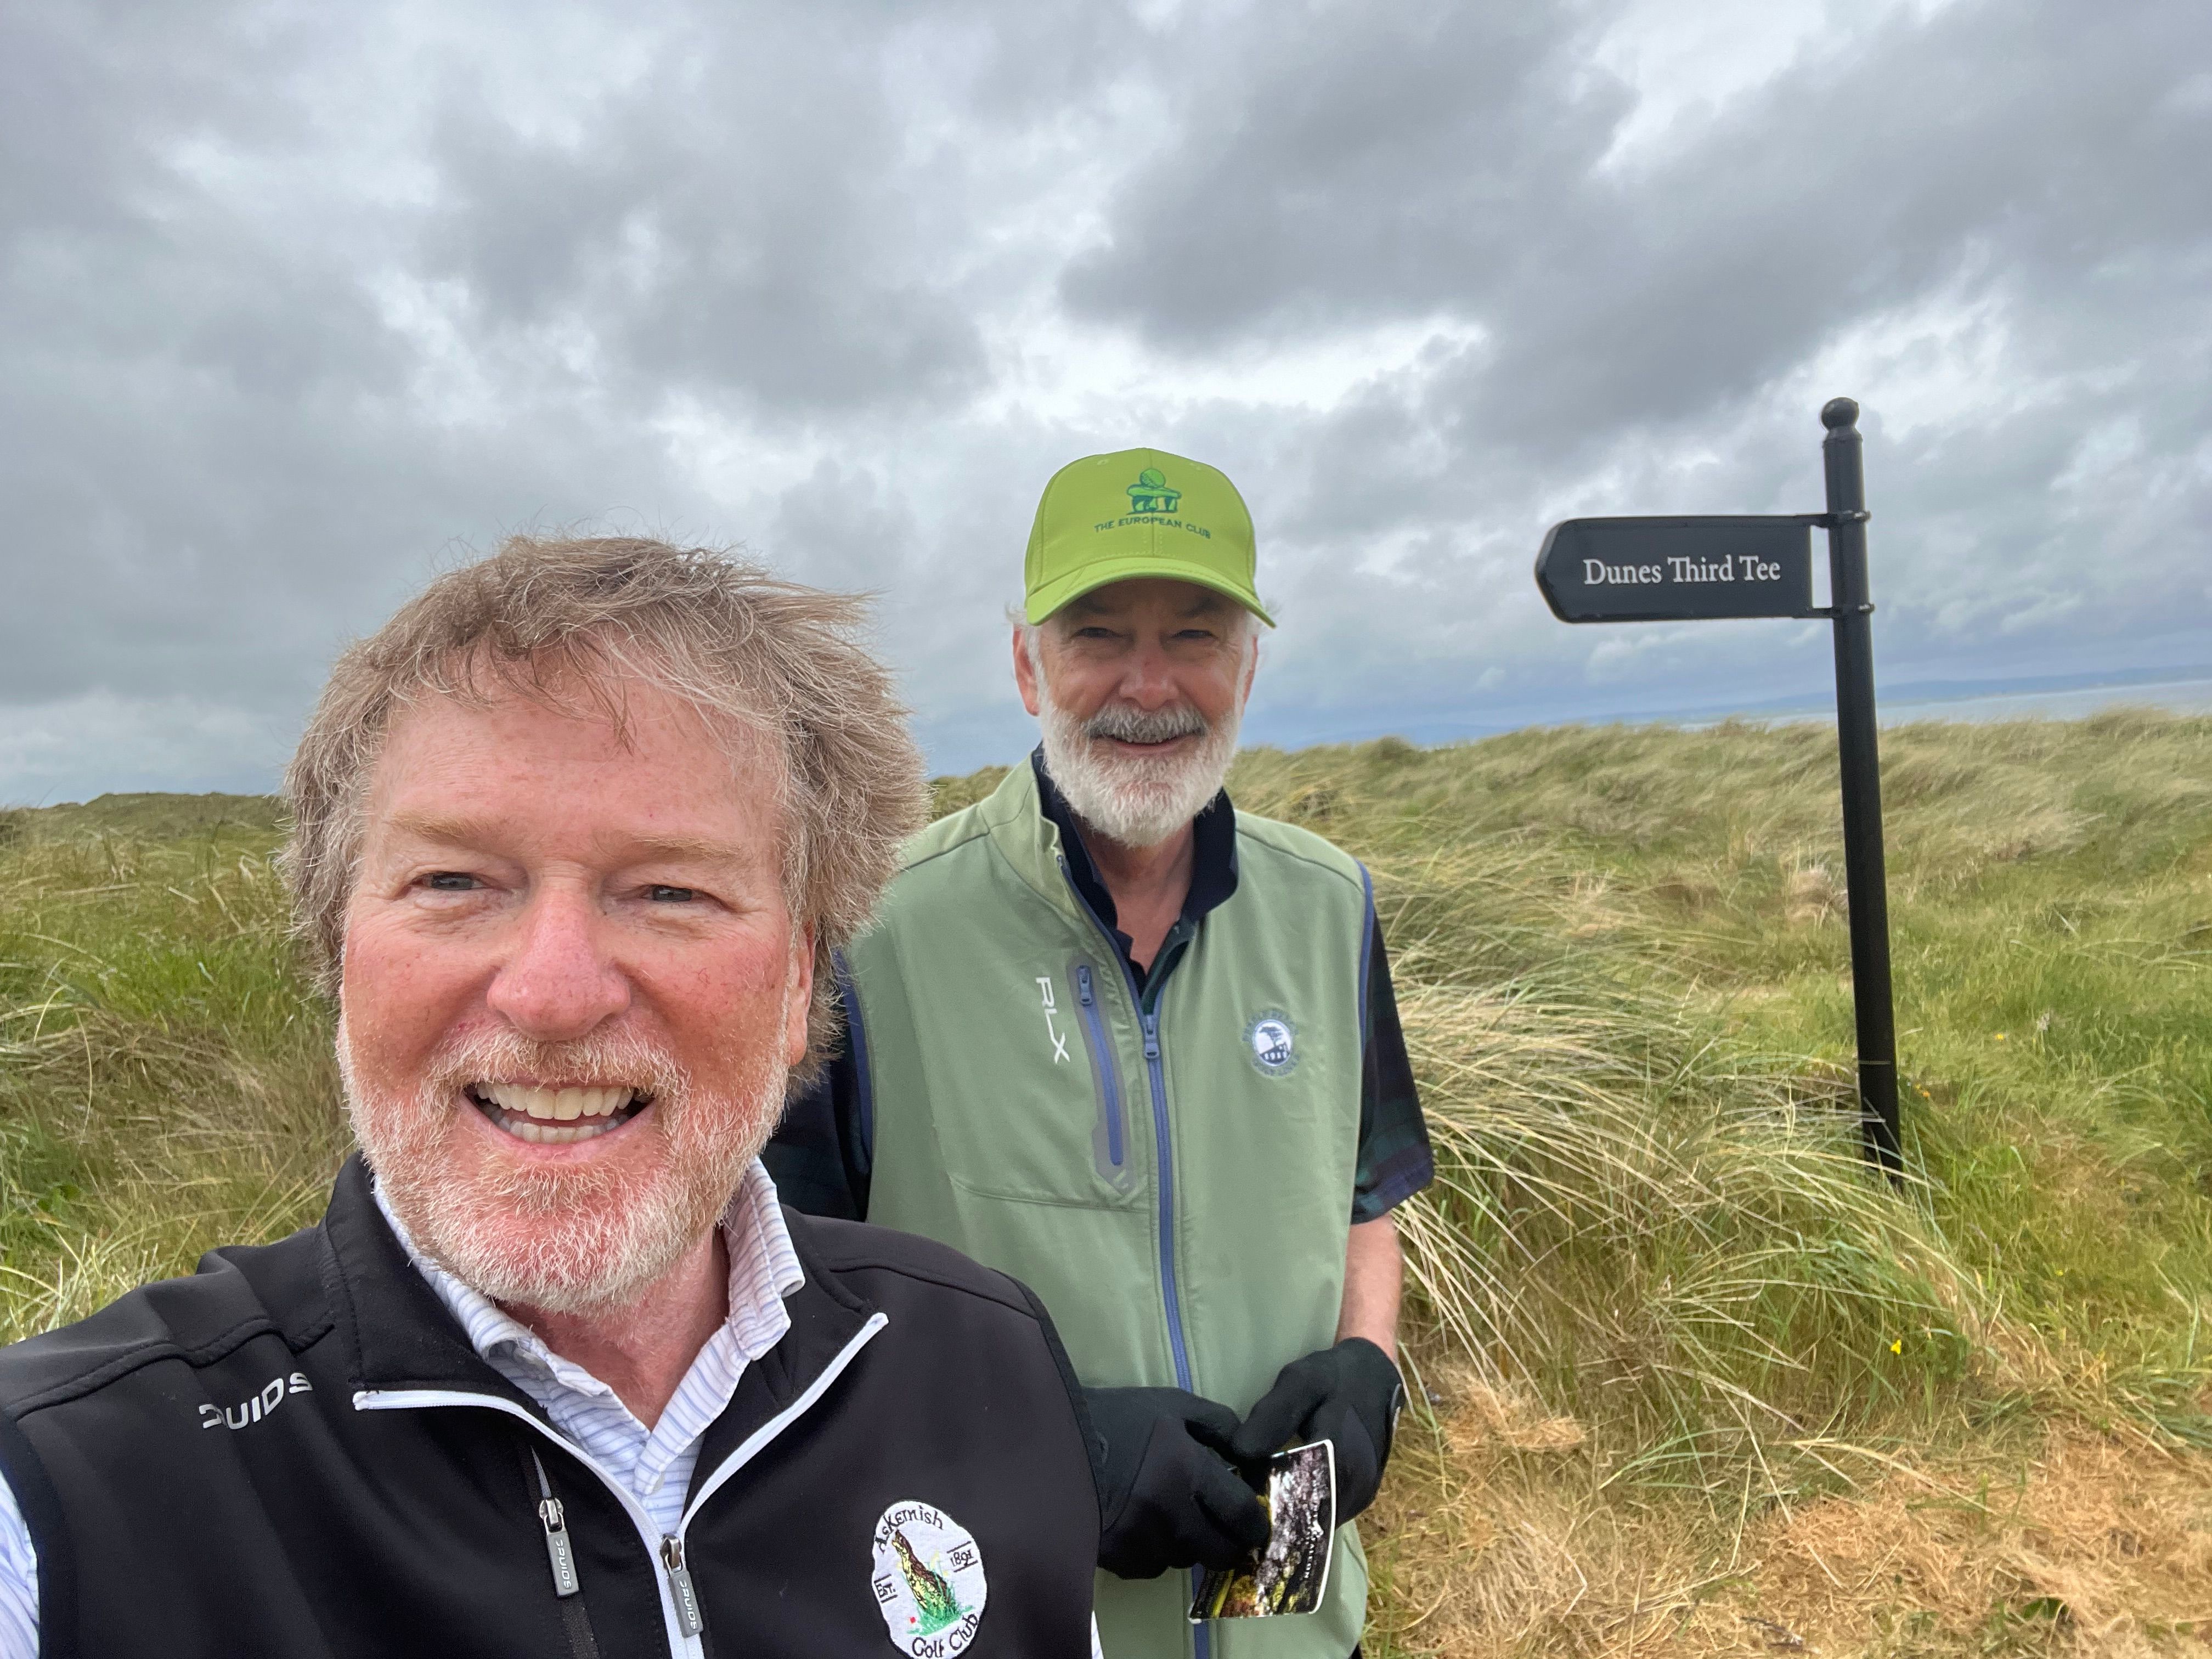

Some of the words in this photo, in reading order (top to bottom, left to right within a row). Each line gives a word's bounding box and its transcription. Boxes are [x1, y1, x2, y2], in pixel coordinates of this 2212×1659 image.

[1093, 521, 1115, 533] THE
[1118, 516, 1182, 529] EUROPEAN
[1186, 523, 1211, 539] CLUB
[1583, 558, 1662, 585] Dunes
[1667, 554, 1735, 583] Third
[1739, 555, 1781, 582] Tee
[1035, 977, 1071, 1064] RLX
[949, 1613, 979, 1651] Club
